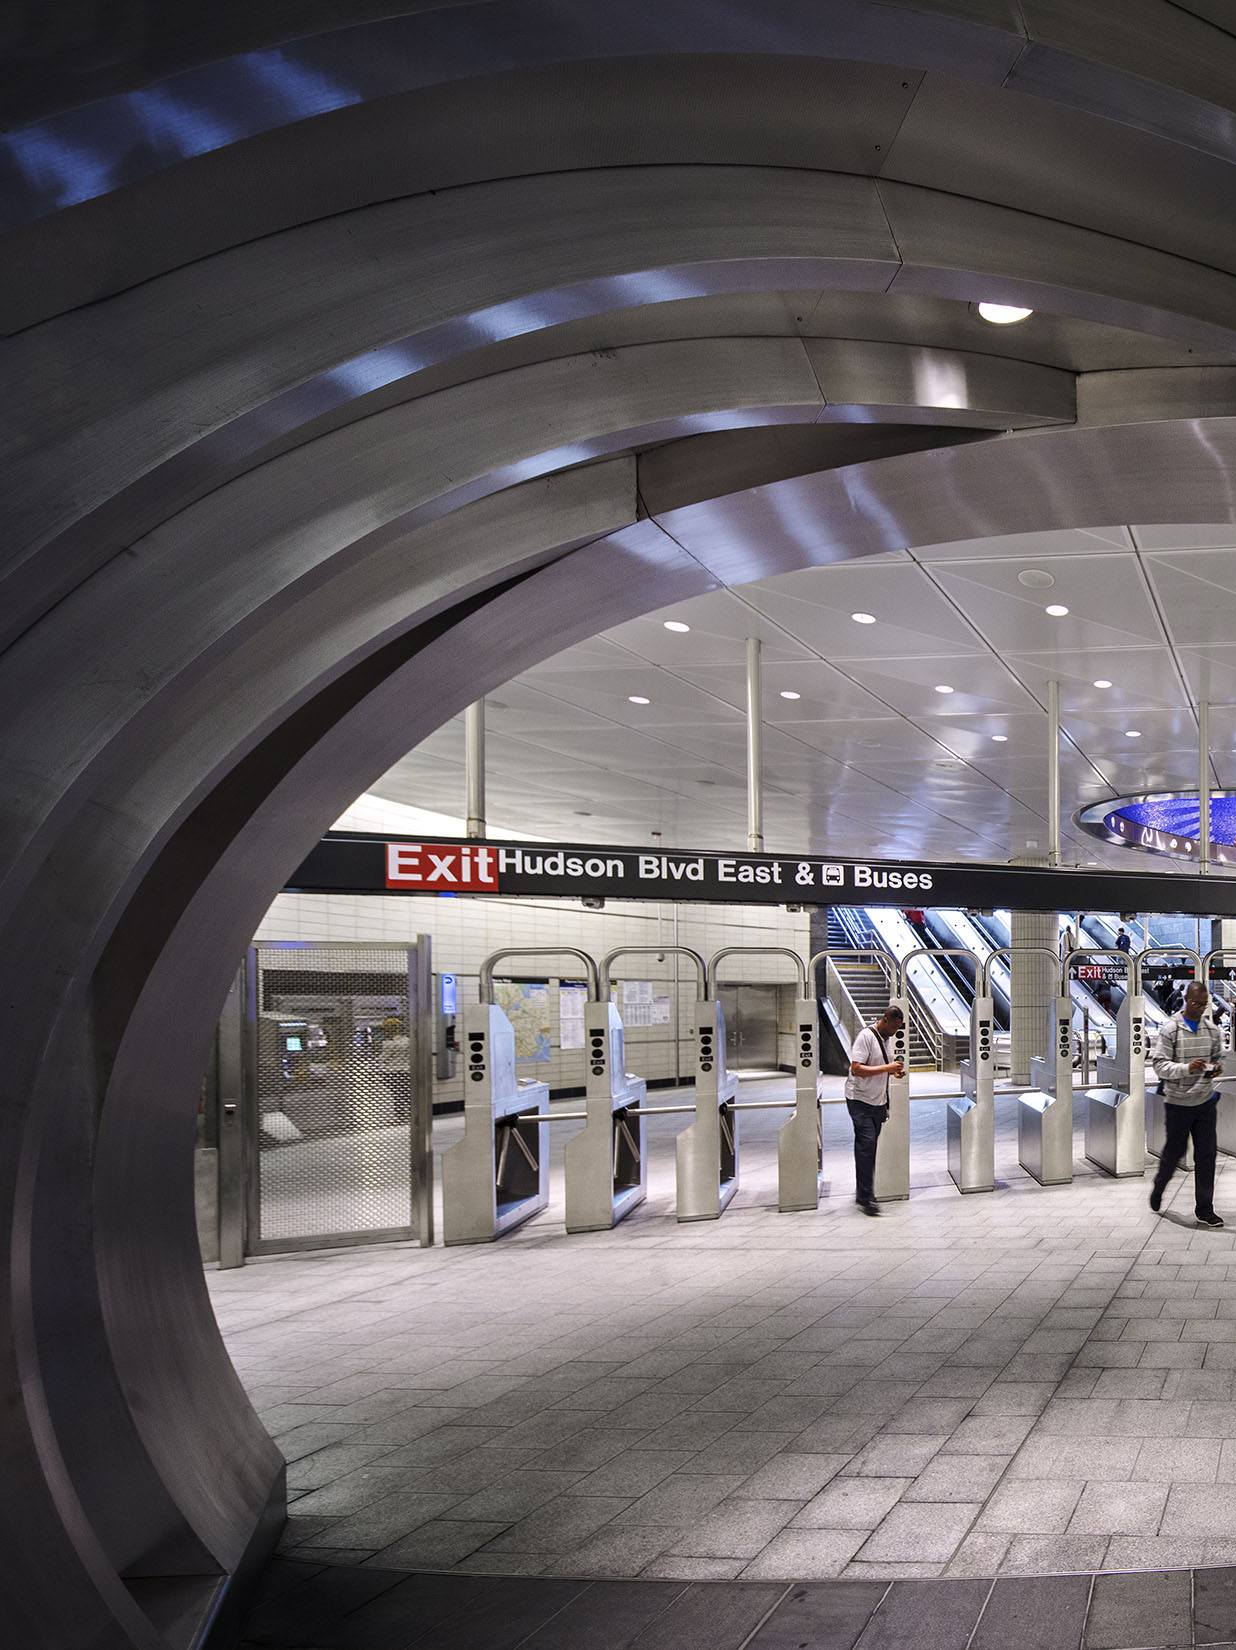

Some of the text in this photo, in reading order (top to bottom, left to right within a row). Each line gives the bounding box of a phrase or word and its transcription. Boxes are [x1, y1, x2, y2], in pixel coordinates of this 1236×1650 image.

[387, 844, 934, 890] Exit Hudson Blvd East & Buses
[1078, 966, 1102, 979] Exit
